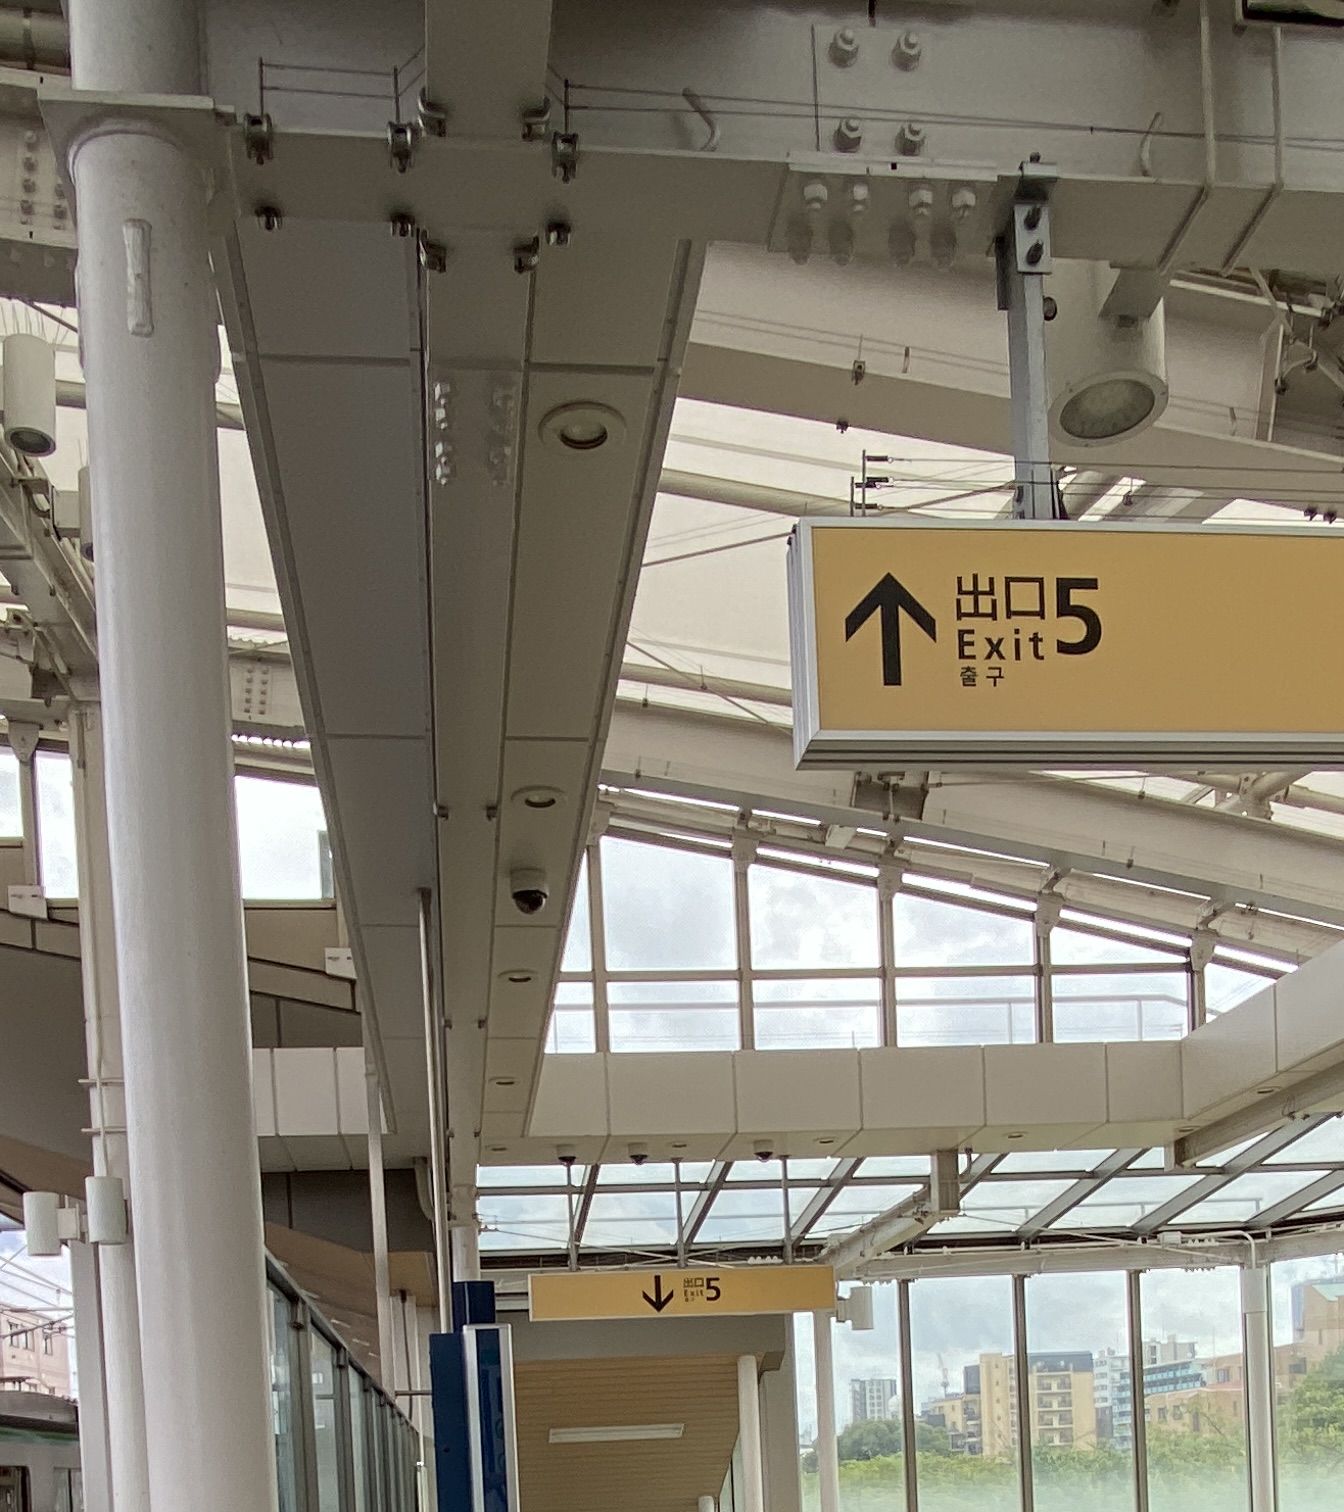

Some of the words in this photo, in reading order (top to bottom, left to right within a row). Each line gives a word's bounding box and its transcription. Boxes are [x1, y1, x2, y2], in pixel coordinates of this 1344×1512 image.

[956, 573, 1046, 621] 出口
[1057, 577, 1102, 656] 5
[957, 628, 1045, 662] Exit
[959, 666, 1005, 688] 출구
[706, 1277, 721, 1302] 5
